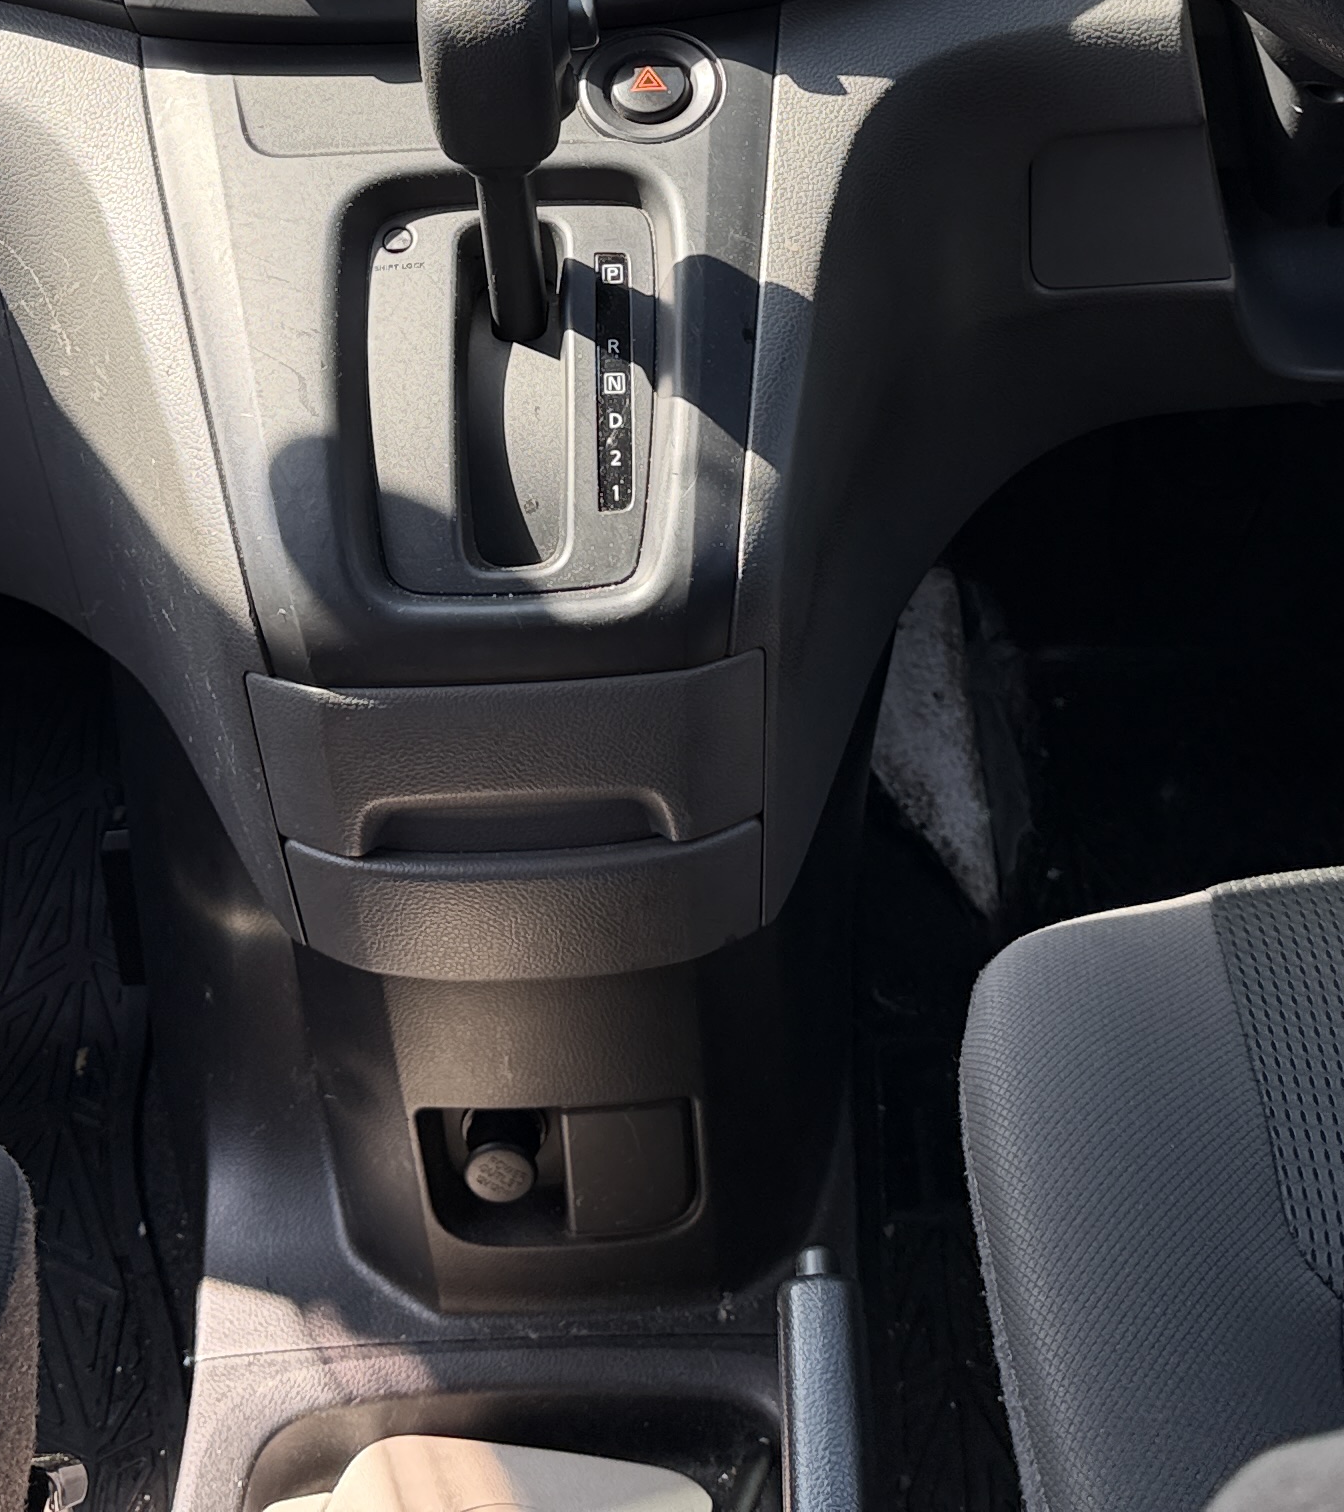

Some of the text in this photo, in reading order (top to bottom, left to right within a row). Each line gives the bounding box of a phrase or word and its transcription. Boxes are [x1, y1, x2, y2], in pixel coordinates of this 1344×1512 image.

[374, 261, 426, 272] SHIFT LOCK
[607, 338, 621, 354] R
[608, 412, 624, 429] D
[609, 449, 622, 467] 2
[611, 484, 620, 502] 1
[489, 1155, 527, 1178] POWER
